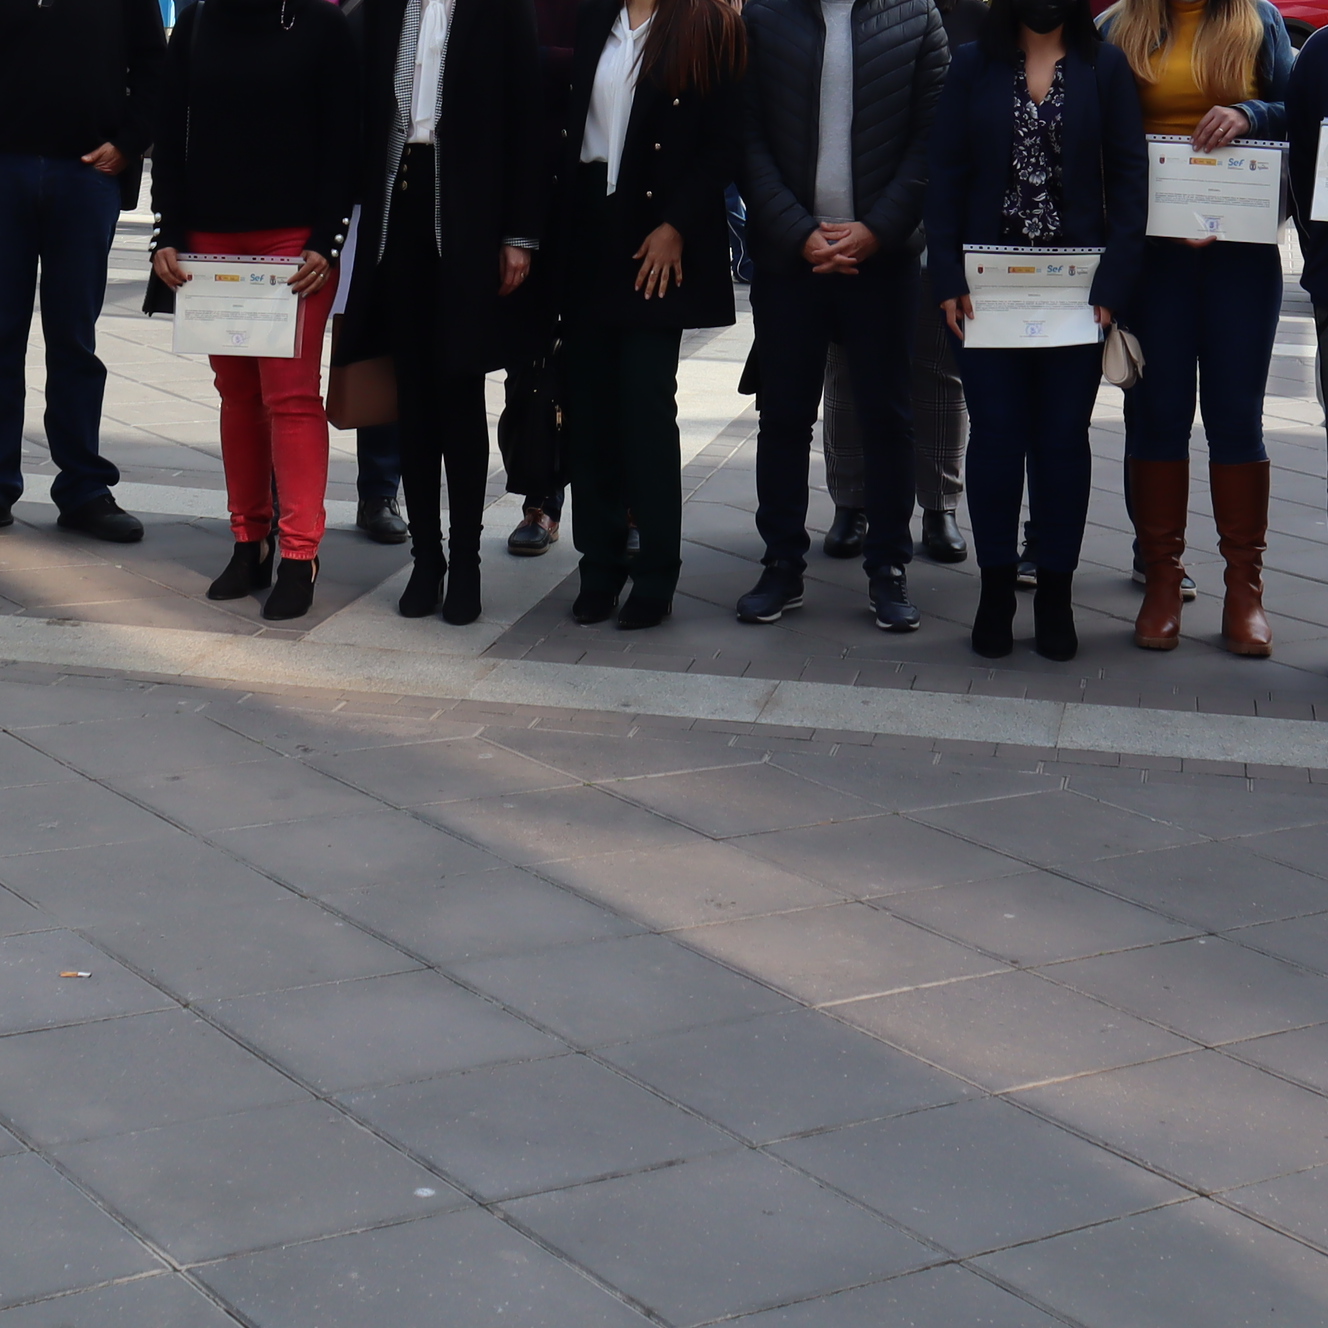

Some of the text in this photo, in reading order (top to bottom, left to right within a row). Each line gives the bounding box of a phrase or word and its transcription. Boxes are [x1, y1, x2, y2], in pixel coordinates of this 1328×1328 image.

[1228, 157, 1245, 167] Sef
[1046, 264, 1064, 274] Sef
[249, 273, 265, 282] Sef
